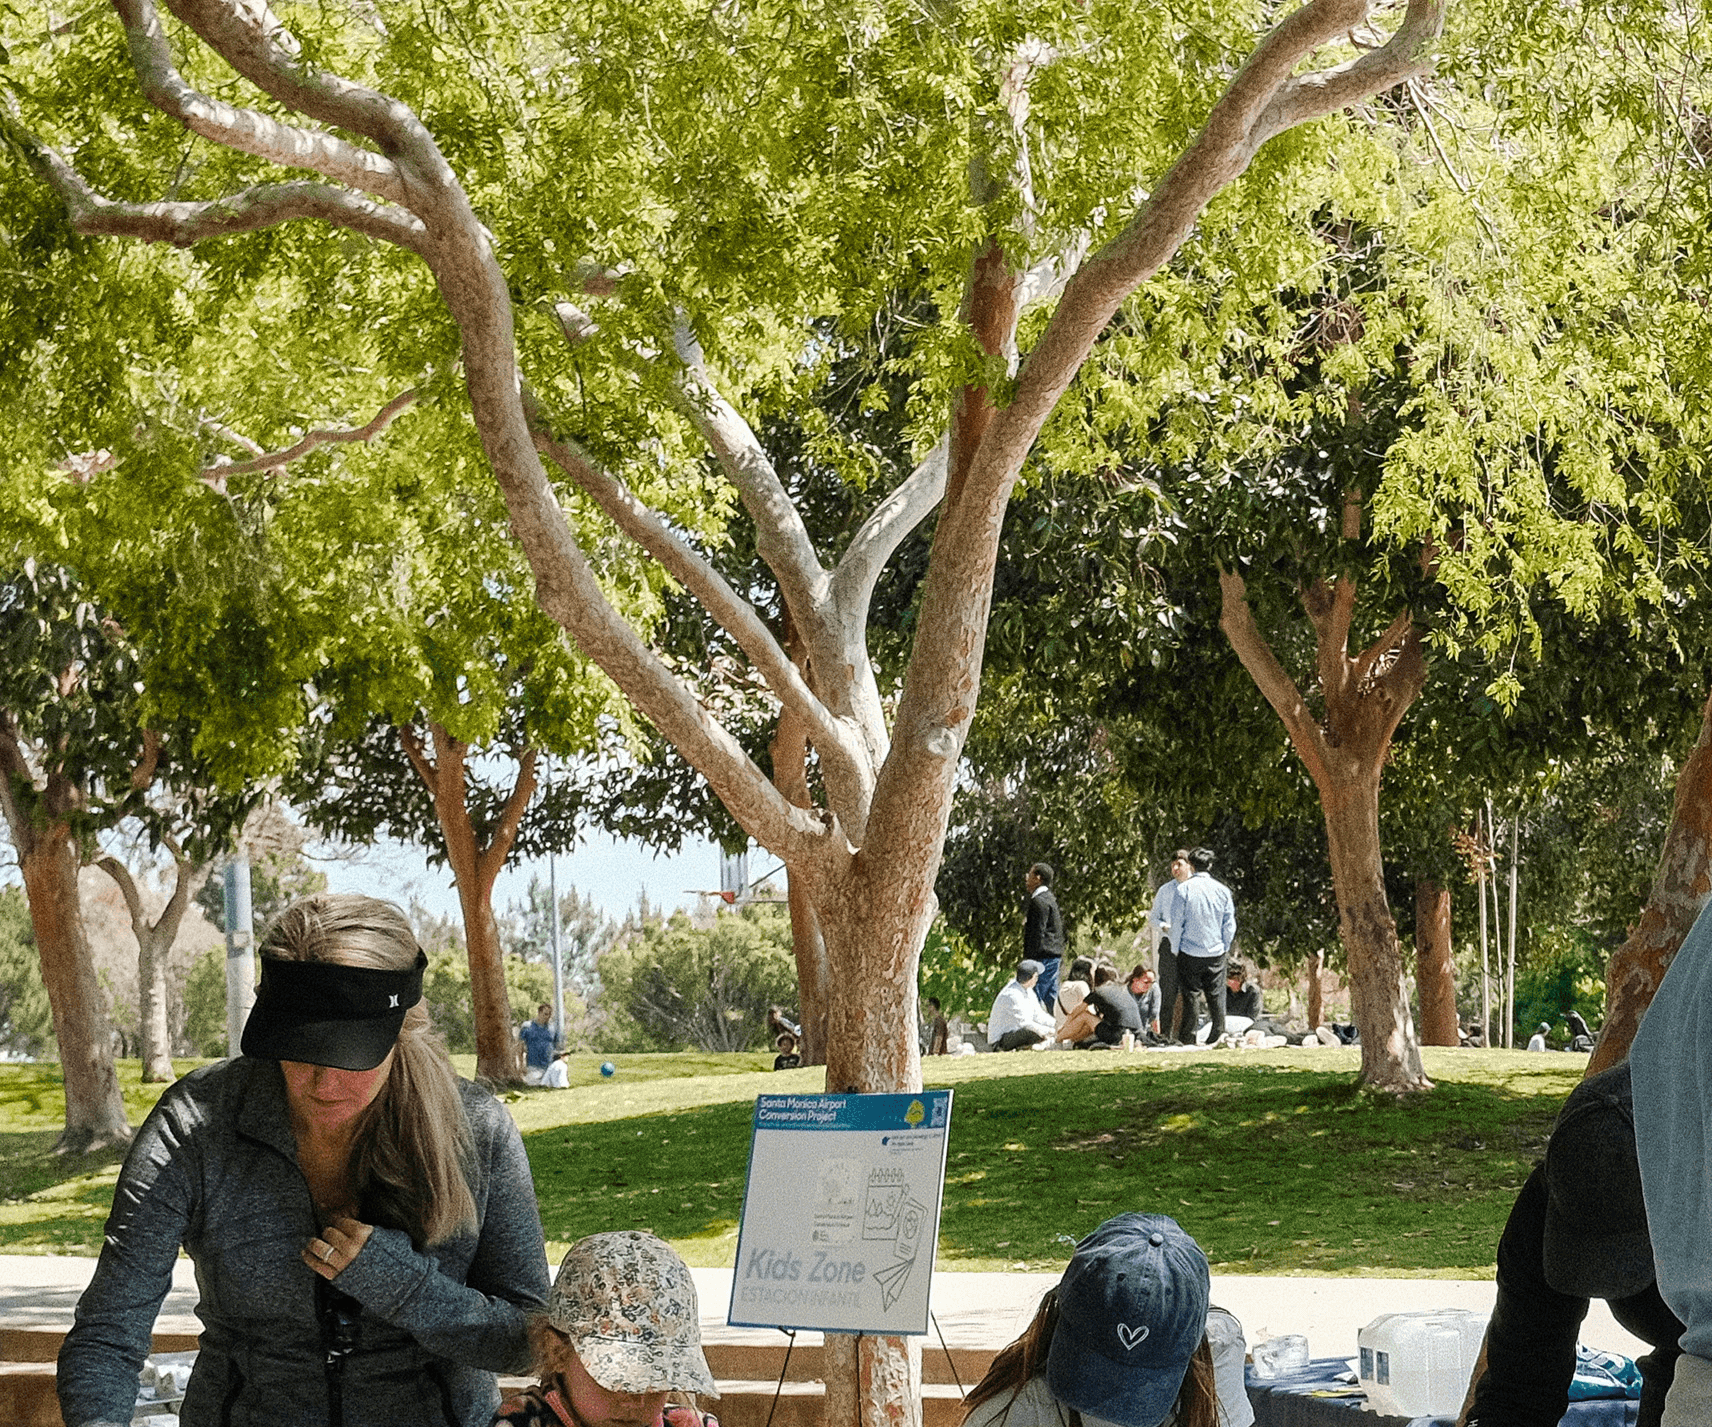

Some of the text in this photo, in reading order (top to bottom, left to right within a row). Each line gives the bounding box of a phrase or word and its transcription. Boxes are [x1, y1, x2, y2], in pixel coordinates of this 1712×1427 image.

[759, 1096, 847, 1111] Santa Monica Airport
[758, 1109, 837, 1124] Conversion Project
[745, 1248, 866, 1284] Kids Zone
